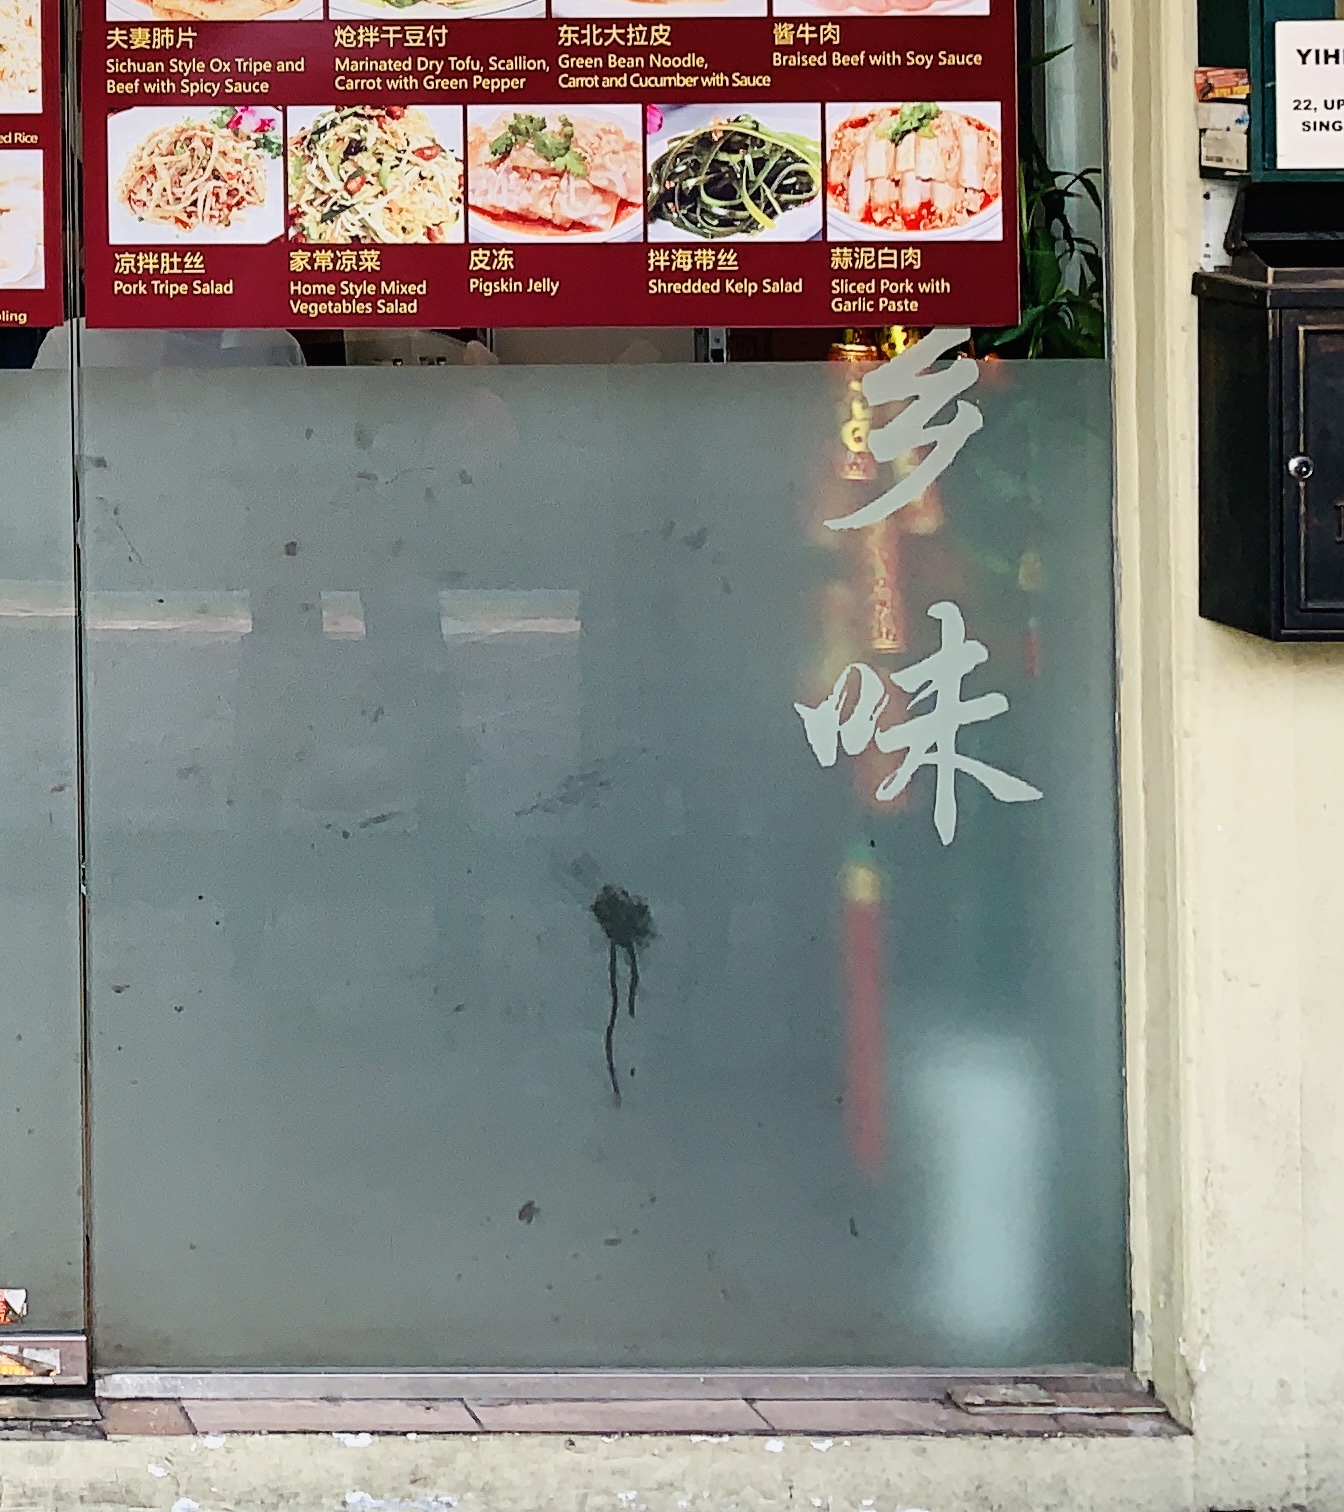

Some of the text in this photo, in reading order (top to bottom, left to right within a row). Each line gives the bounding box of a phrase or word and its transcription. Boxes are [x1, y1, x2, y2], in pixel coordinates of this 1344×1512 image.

[106, 27, 197, 49] 夫妻肺片
[558, 23, 671, 46] 东北大拉皮
[773, 22, 840, 45] 酱牛肉
[335, 56, 549, 74] Marinated Dry Tofu, Scallion,
[558, 53, 708, 69] Green Bean Noodle,
[773, 50, 982, 69] Braised Beef with Soy Sauce
[1296, 48, 1344, 65] YIH
[106, 57, 304, 76] Sichuan Style Ox Tripe and
[107, 78, 269, 97] Beef with Spicy Sauce
[1292, 99, 1318, 113] 22,
[114, 252, 205, 274] 凉拌肚丝
[290, 249, 380, 272] 家常凉菜
[469, 248, 514, 271] 皮冻
[648, 248, 739, 271] 拌海带丝
[831, 247, 921, 269] 蒜泥白肉
[114, 279, 233, 298] Pork Tripe Salad
[290, 280, 426, 298] Home Style Mixed
[470, 277, 559, 296] Pigskin Jelly
[648, 278, 802, 297] Shredded Kelp Salad
[831, 278, 950, 294] Sliced Pork with
[290, 300, 417, 317] Vegetables Salad
